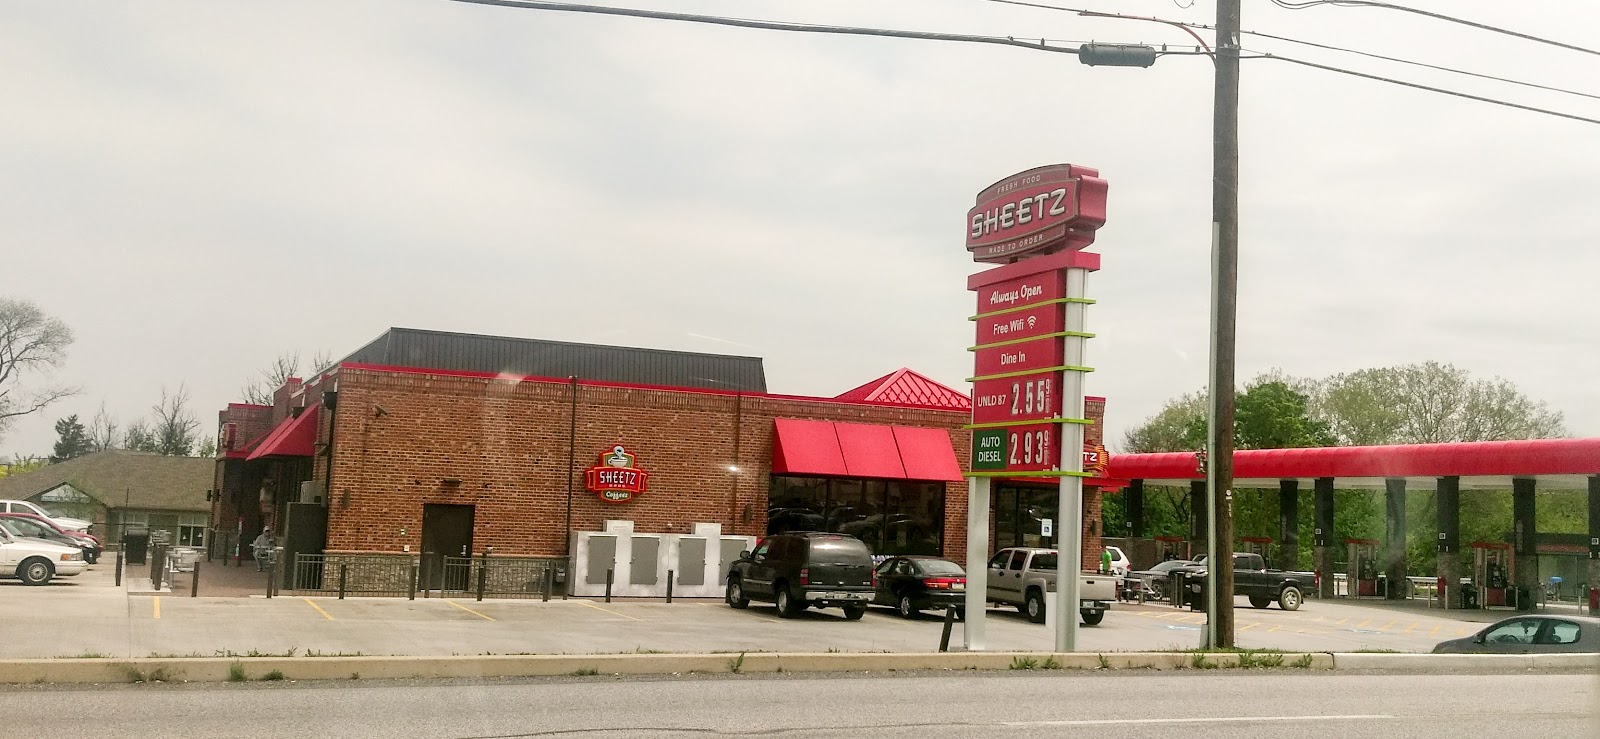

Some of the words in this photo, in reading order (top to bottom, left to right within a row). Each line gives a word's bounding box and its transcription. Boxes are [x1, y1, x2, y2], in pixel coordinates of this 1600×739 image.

[997, 181, 1018, 195] FRESH
[1022, 175, 1041, 186] FOOD
[971, 188, 1066, 239] SHEETZ
[988, 244, 1005, 254] MADE
[1008, 242, 1016, 250] TO
[1019, 234, 1043, 247] ORDER
[990, 289, 1019, 305] Always
[1020, 284, 1042, 300] Open
[993, 323, 1008, 335] Free
[1010, 318, 1024, 332] Wifi
[1001, 353, 1017, 365] Dine
[1018, 351, 1026, 363] In
[977, 395, 997, 407] UNLD
[997, 394, 1006, 405] 87
[981, 436, 1000, 448] AUTO
[978, 451, 1001, 462] DIESEL
[599, 471, 636, 485] SHEETZ
